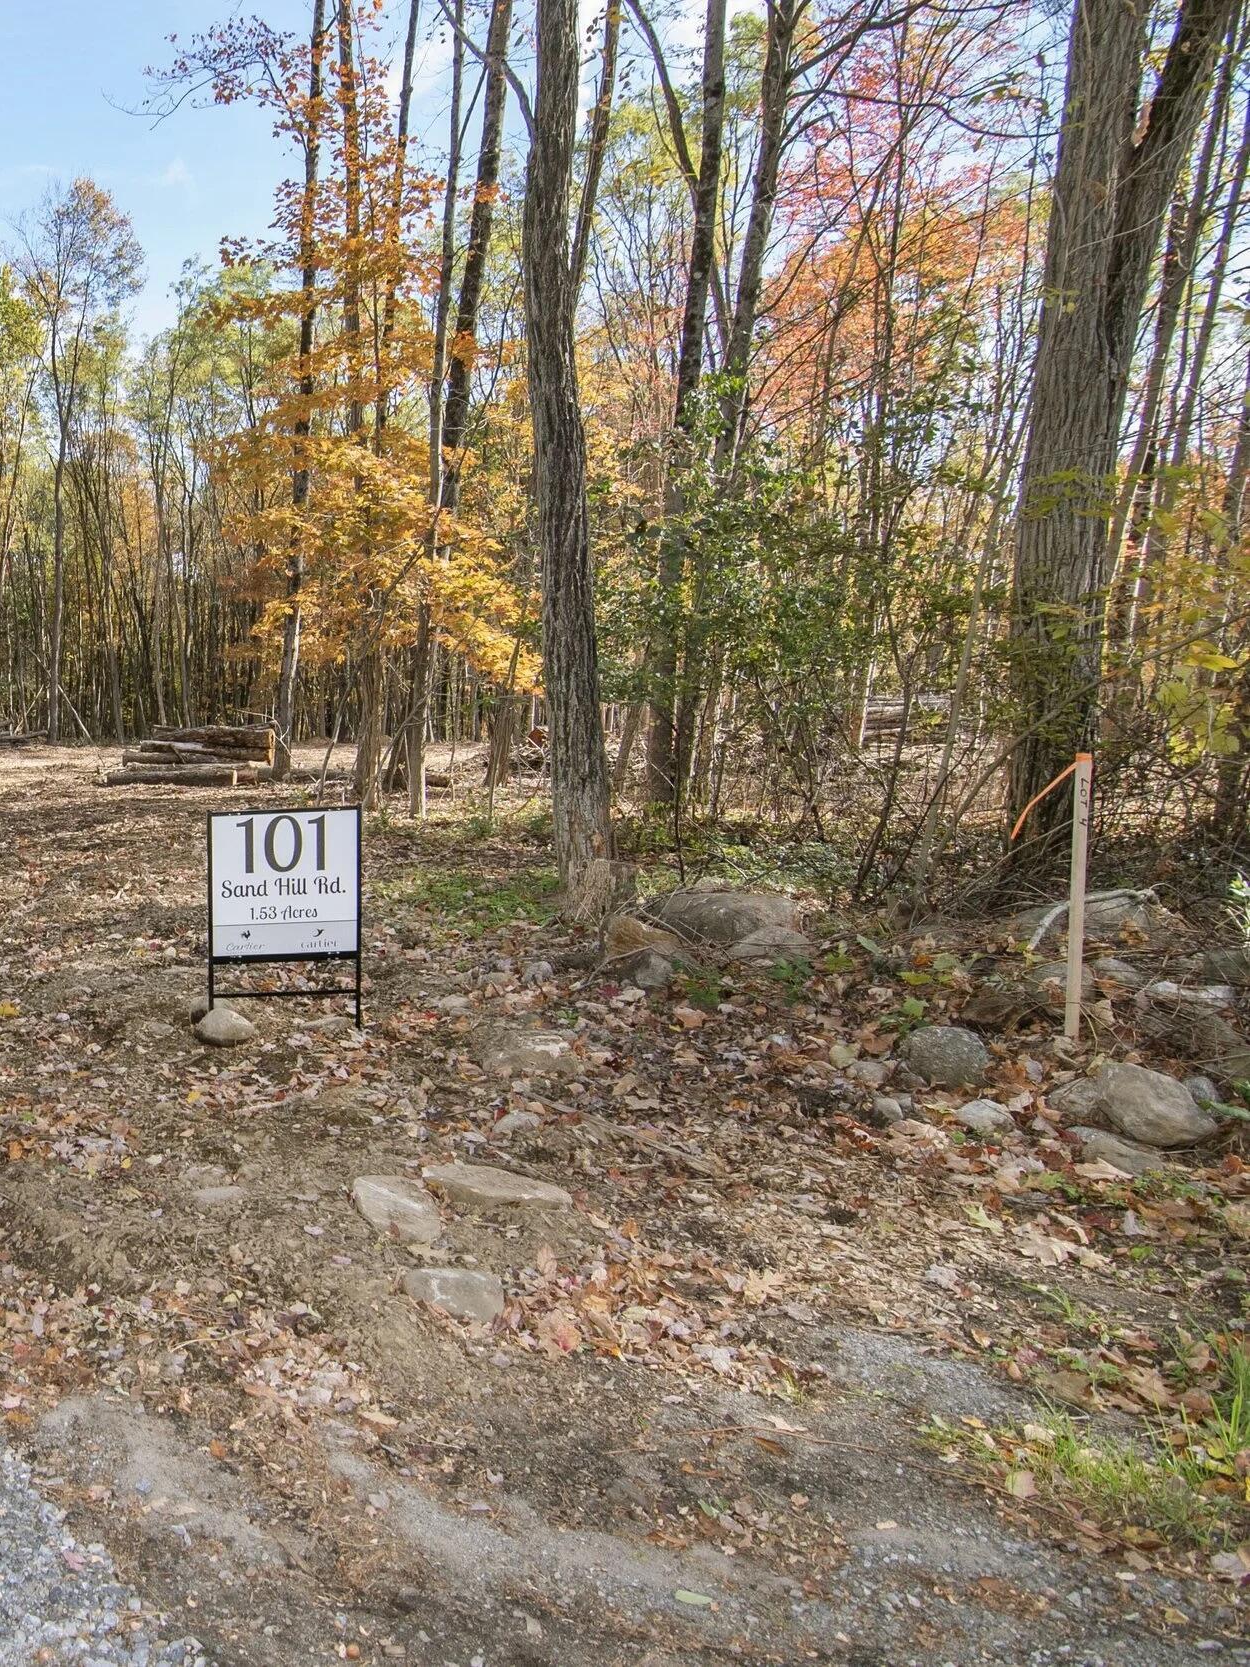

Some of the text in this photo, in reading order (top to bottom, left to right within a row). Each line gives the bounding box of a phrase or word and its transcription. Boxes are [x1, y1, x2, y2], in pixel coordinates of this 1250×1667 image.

[1079, 777, 1089, 827] LOT 4
[236, 814, 326, 874] 101
[221, 876, 347, 899] Sand Hill Rd.
[250, 905, 318, 921] 1.53 Acres
